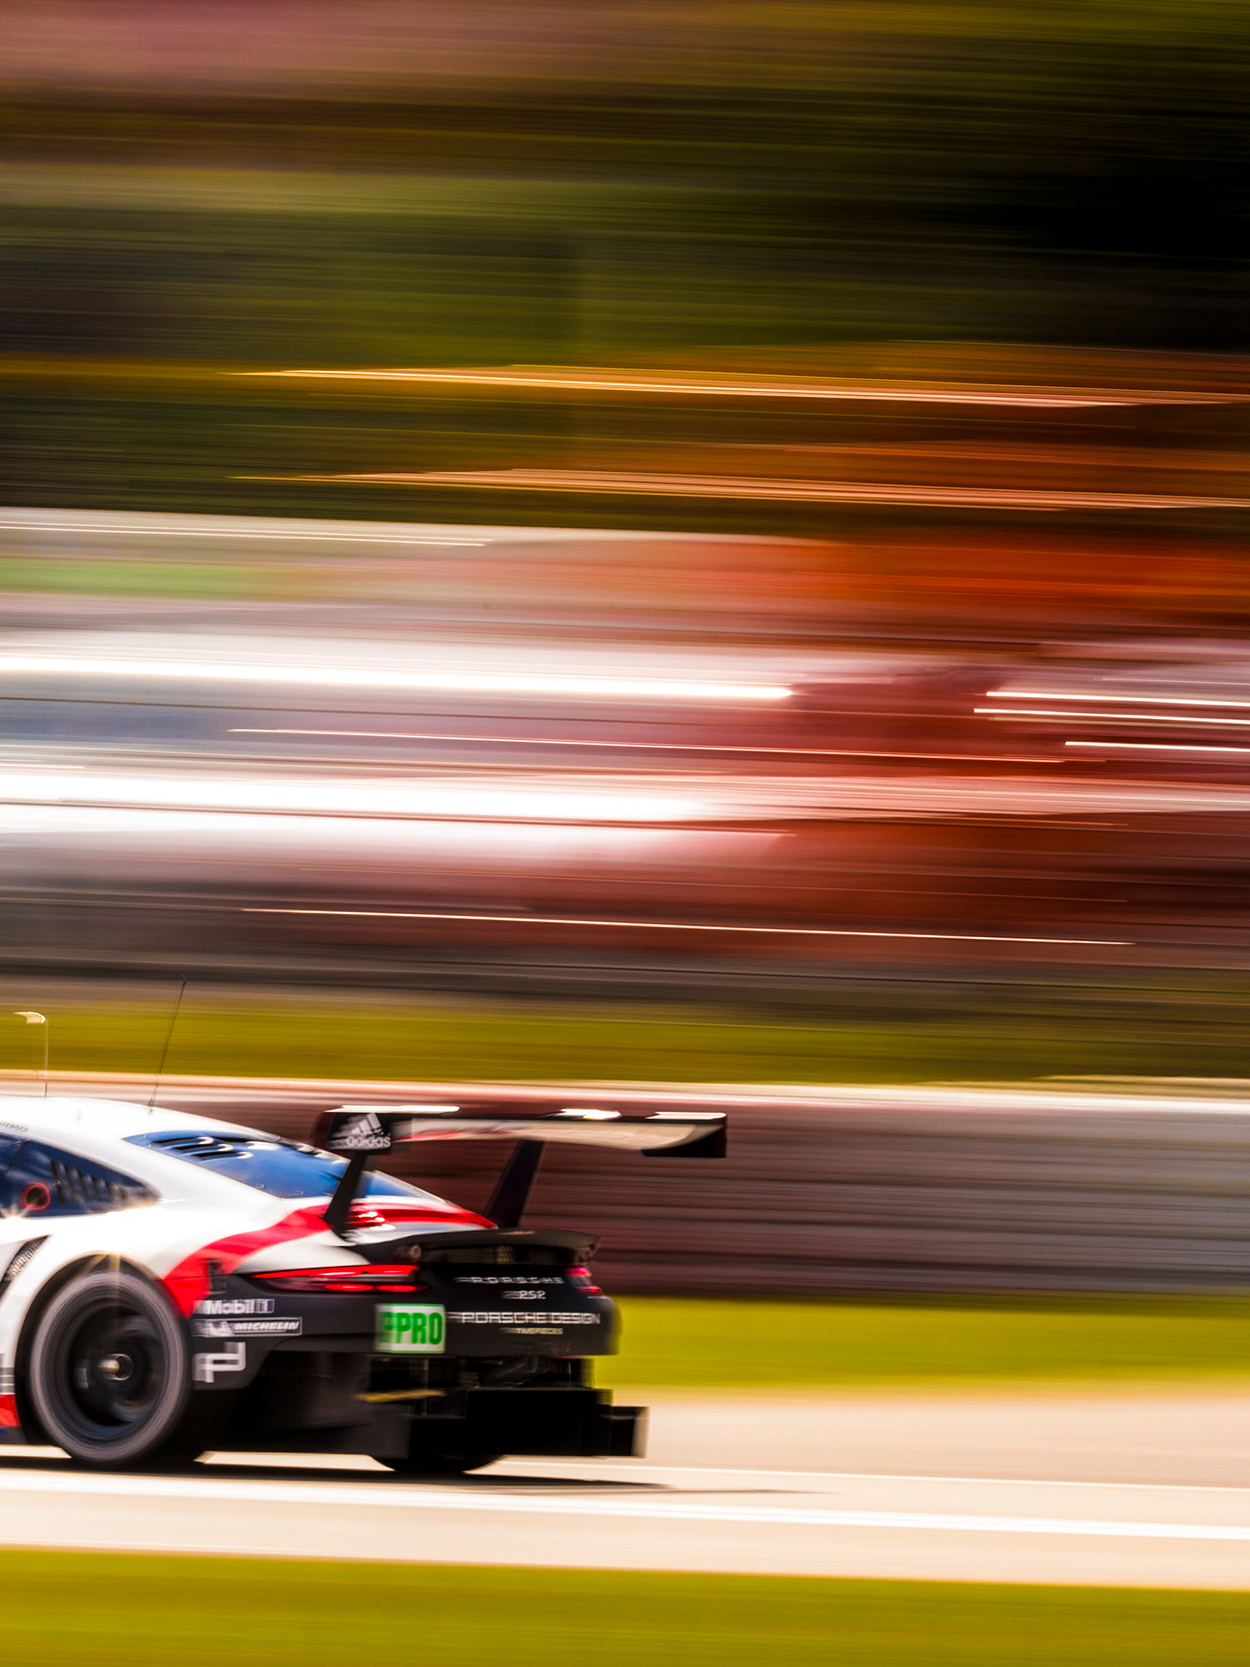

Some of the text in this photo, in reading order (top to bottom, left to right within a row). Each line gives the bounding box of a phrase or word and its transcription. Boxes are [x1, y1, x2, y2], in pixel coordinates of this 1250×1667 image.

[346, 1134, 392, 1148] adidas
[470, 1276, 565, 1285] PORSCHE
[205, 1299, 255, 1315] Mobil
[461, 1311, 601, 1325] PORSCHE DESIGN
[235, 1321, 300, 1331] MICHELIN
